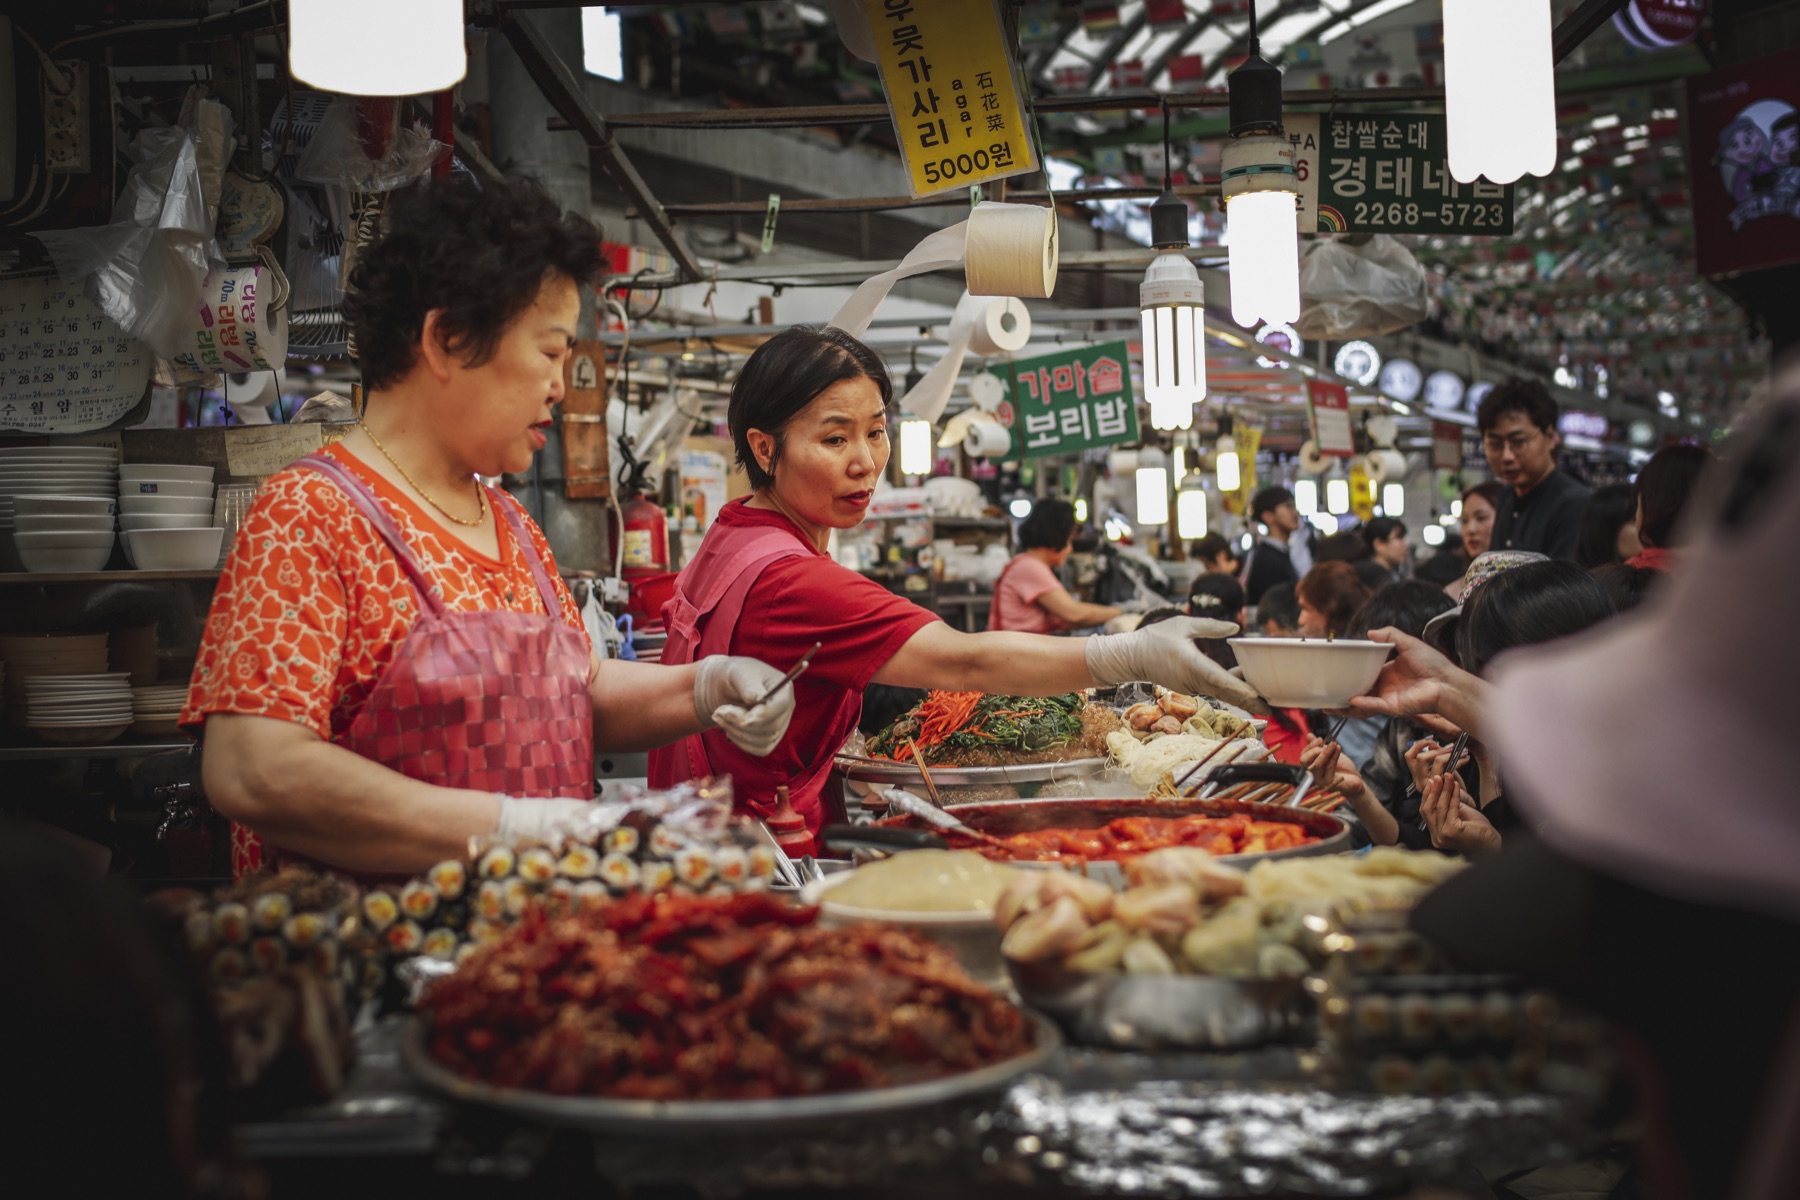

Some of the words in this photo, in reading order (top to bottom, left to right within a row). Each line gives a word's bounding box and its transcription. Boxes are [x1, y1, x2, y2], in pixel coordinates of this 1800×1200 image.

[884, 0, 949, 148] 우뭇가사리
[951, 78, 973, 138] agar
[975, 71, 1005, 132] 石花菜
[1288, 133, 1317, 150] 부A
[1330, 119, 1428, 150] 찹쌀순대
[924, 141, 1013, 183] 5000원
[1354, 202, 1504, 226] 2268-5723
[221, 280, 235, 303] 70m
[20, 304, 26, 312] 7
[43, 301, 50, 310] 8
[67, 299, 75, 308] 9
[19, 327, 29, 335] 14
[43, 325, 53, 334] 15
[67, 323, 78, 332] 16
[92, 321, 102, 330] 17
[18, 351, 29, 360] 21
[43, 349, 54, 358] 22
[67, 347, 78, 356] 23
[92, 345, 103, 354] 24
[117, 344, 128, 353] 25
[18, 375, 30, 385] 28
[43, 373, 54, 382] 29
[67, 371, 79, 380] 30
[92, 370, 102, 379] 31
[1017, 356, 1124, 405] 가마솥
[995, 401, 1015, 428] 9
[1025, 396, 1128, 448] 보리밥
